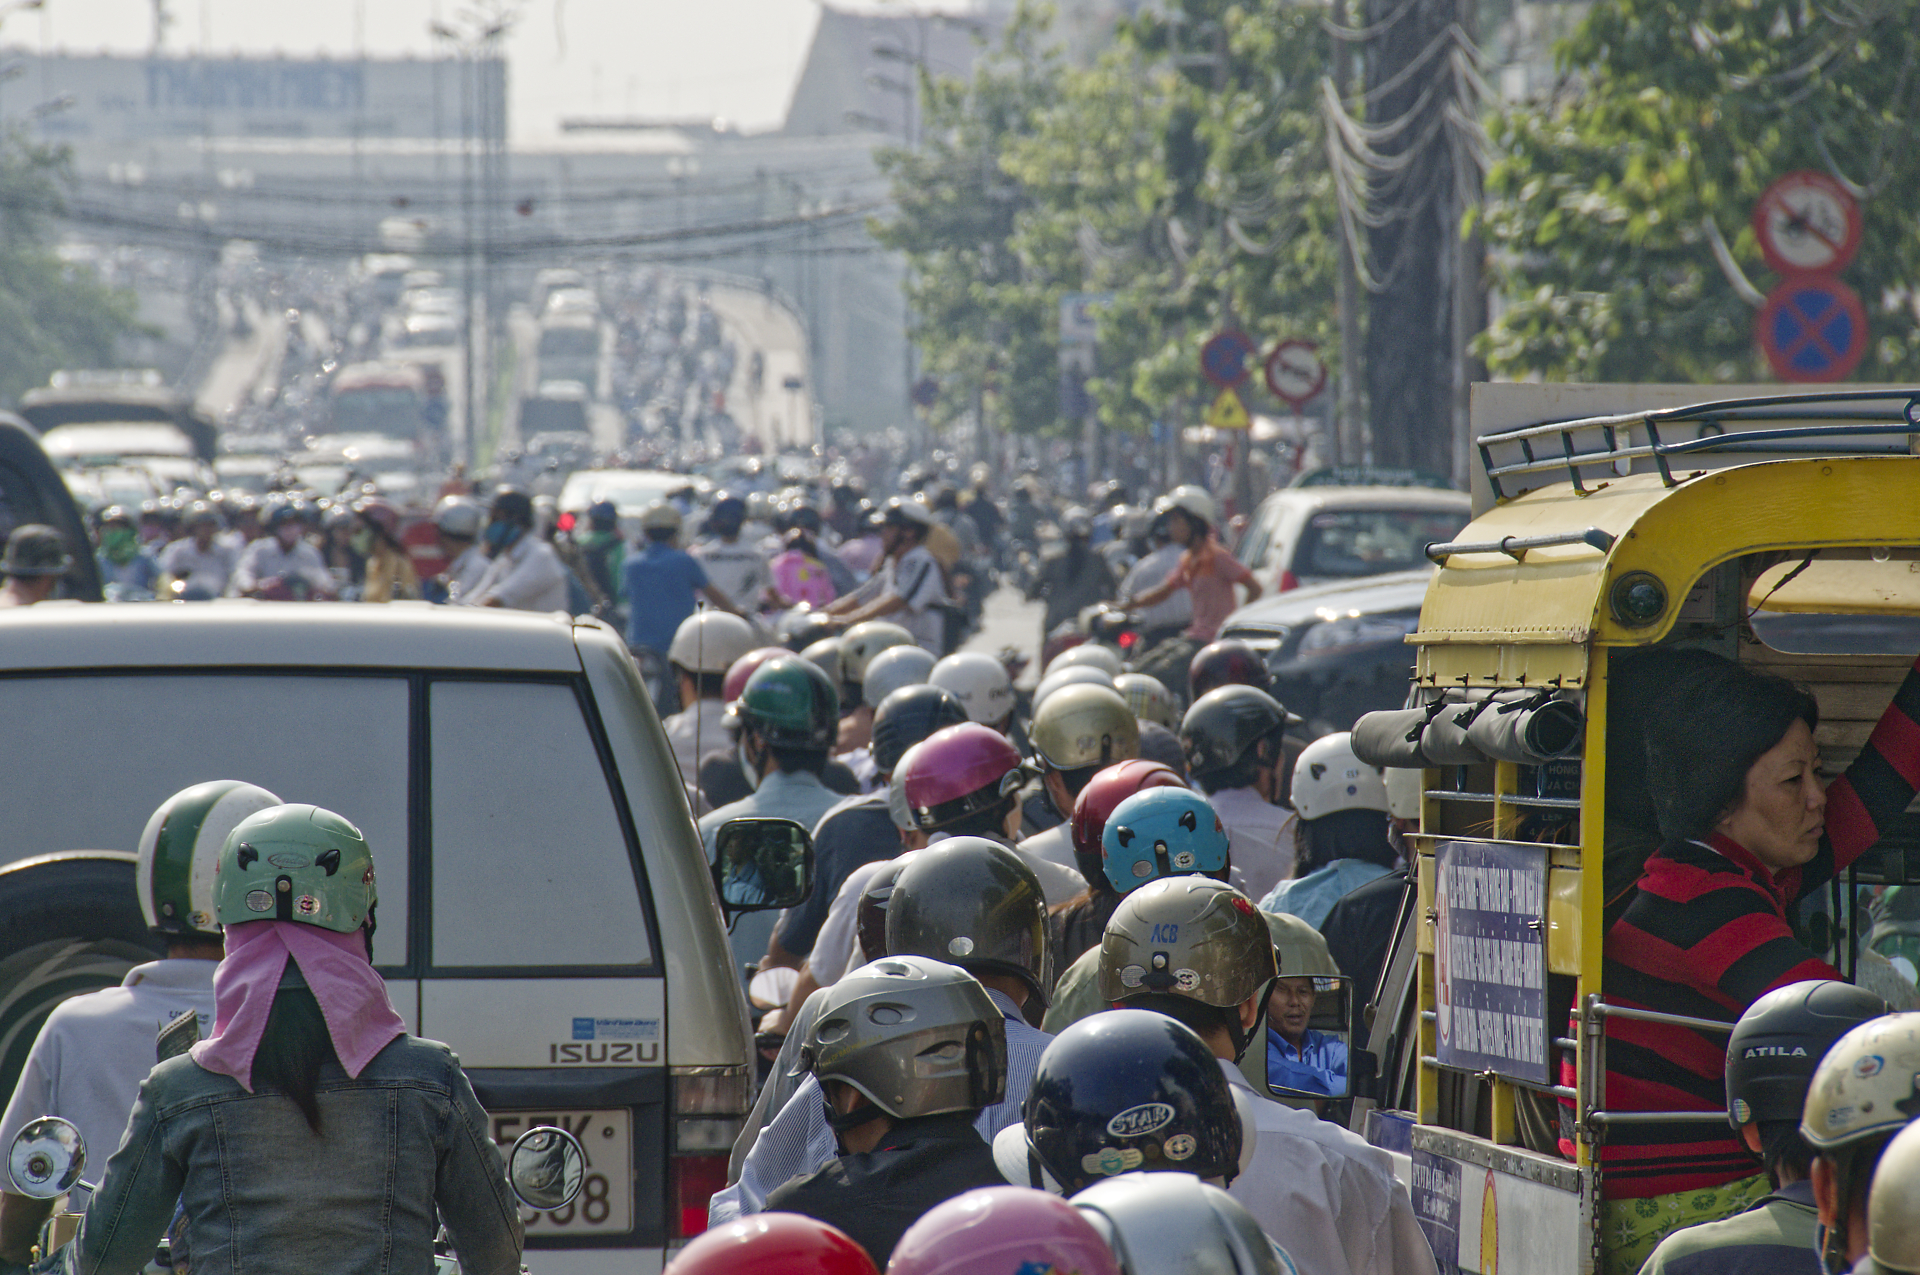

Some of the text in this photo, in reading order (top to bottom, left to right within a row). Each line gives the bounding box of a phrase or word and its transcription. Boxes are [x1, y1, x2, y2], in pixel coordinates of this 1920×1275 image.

[1151, 923, 1179, 943] ACB
[550, 1043, 658, 1063] ISUZU
[1745, 1046, 1807, 1059] ATILA
[1113, 1106, 1166, 1132] STAR
